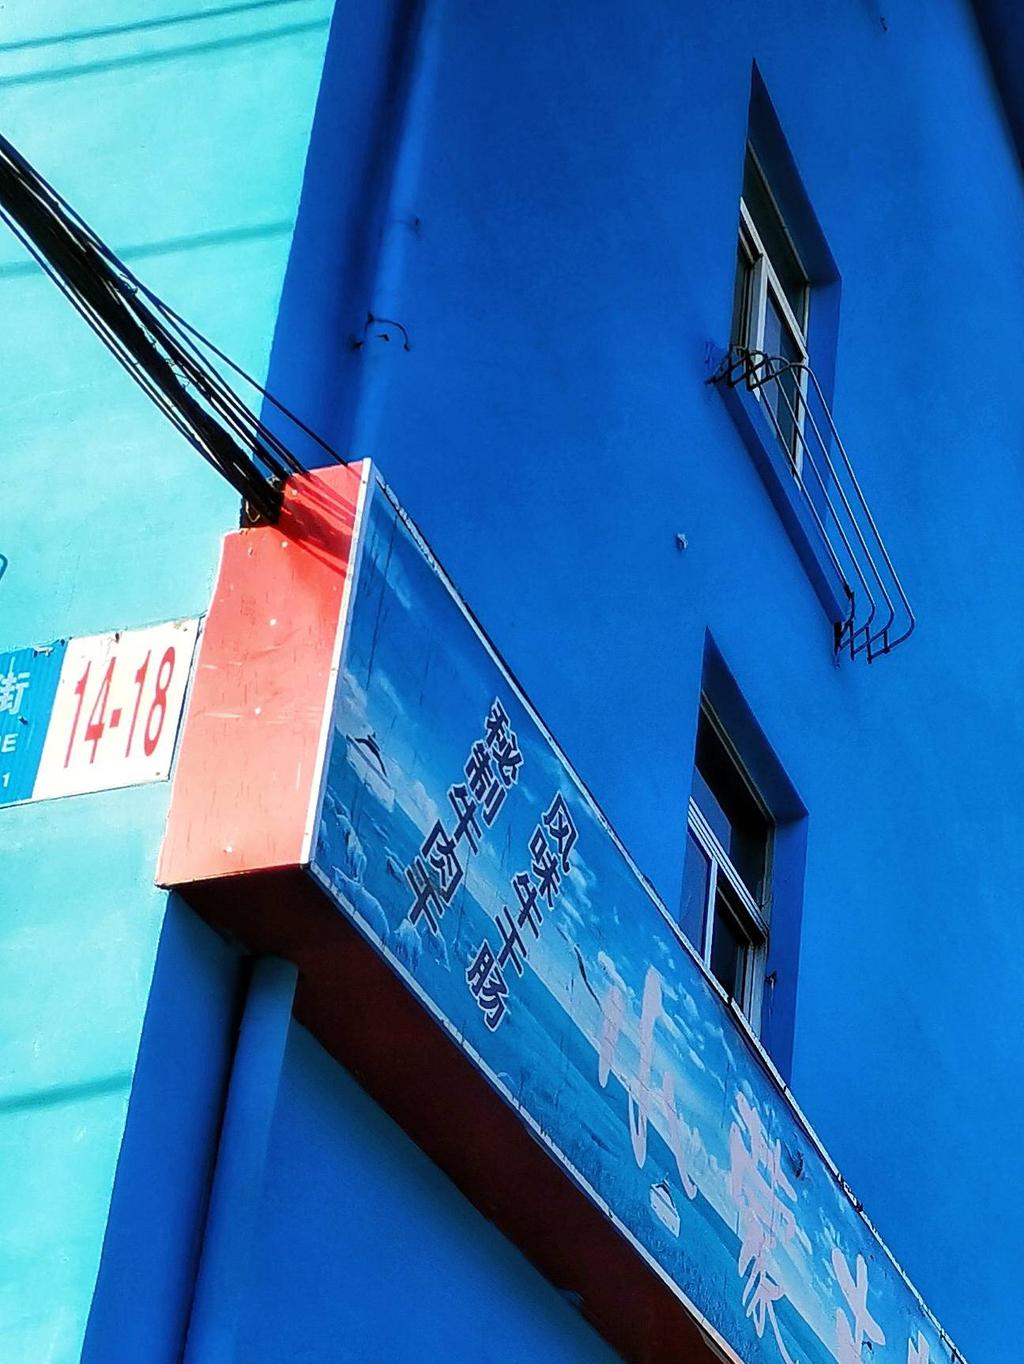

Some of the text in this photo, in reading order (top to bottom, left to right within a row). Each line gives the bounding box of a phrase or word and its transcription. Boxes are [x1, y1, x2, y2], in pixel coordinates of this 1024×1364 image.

[63, 646, 176, 768] 14-18
[404, 697, 524, 935] 秘制牛肉干
[465, 790, 578, 1032] 风味牛干肠
